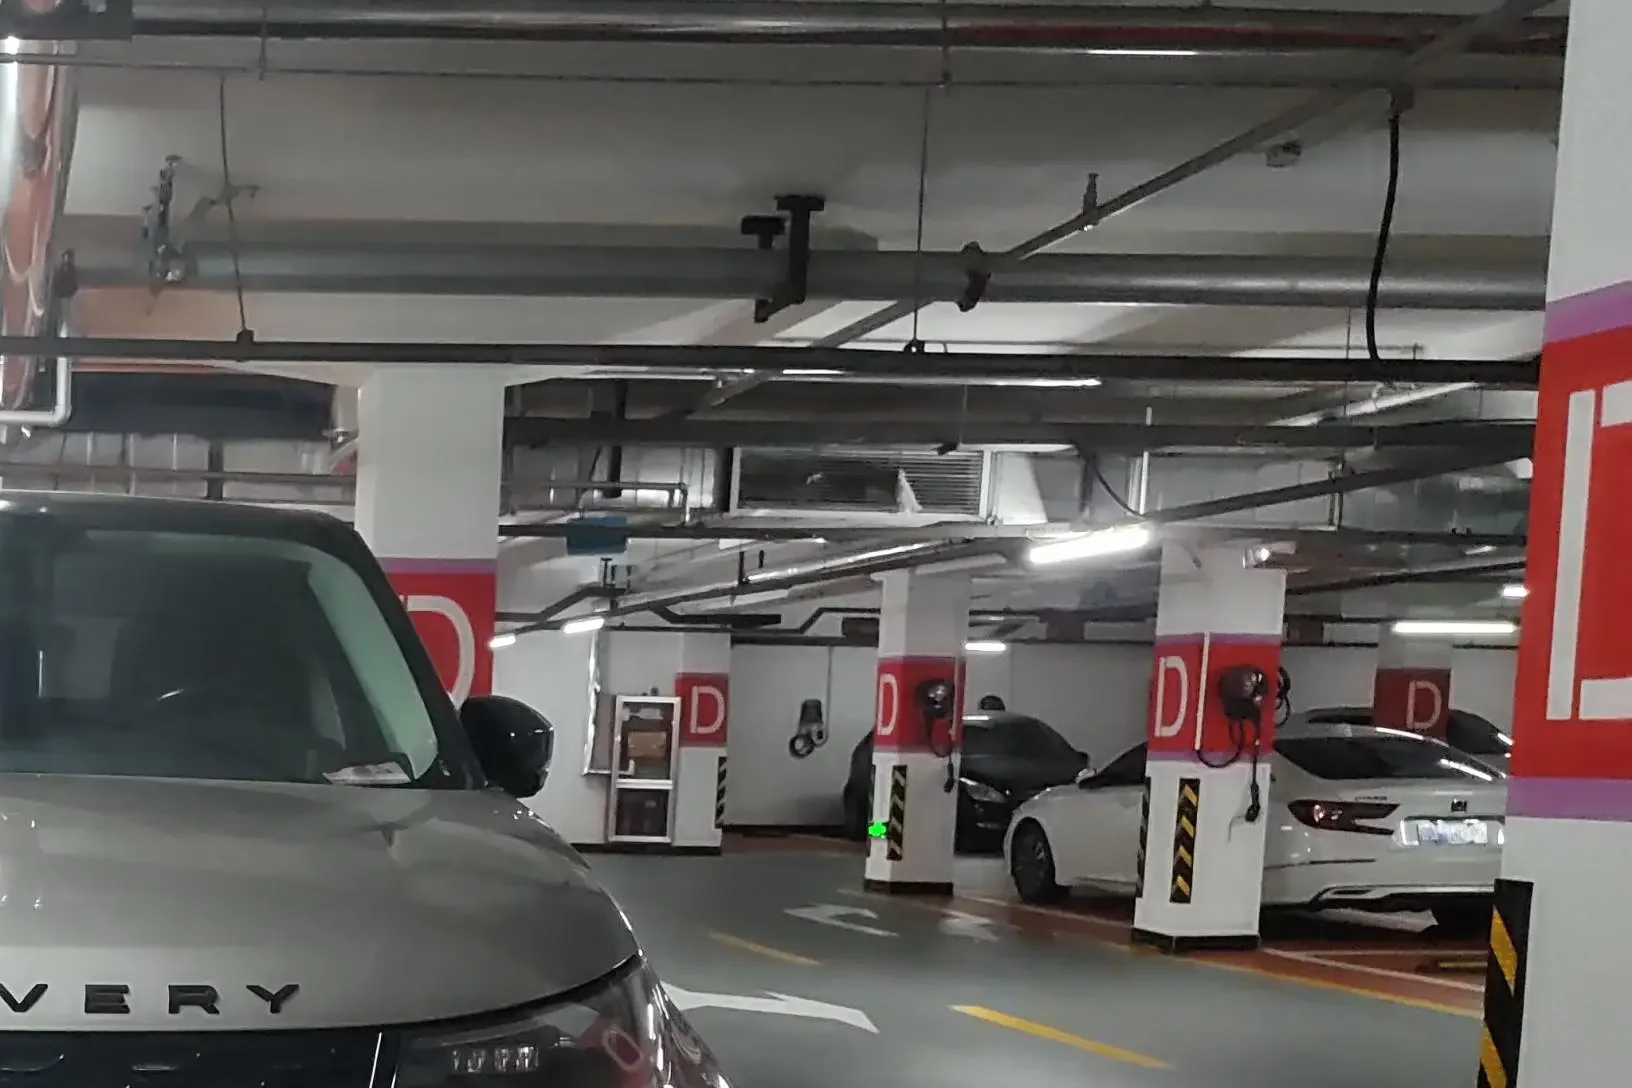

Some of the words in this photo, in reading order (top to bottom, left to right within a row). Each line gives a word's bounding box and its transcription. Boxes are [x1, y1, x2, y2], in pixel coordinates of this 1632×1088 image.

[689, 684, 726, 735] D
[876, 673, 899, 736] D
[1153, 655, 1189, 738] D
[1405, 680, 1443, 731] D
